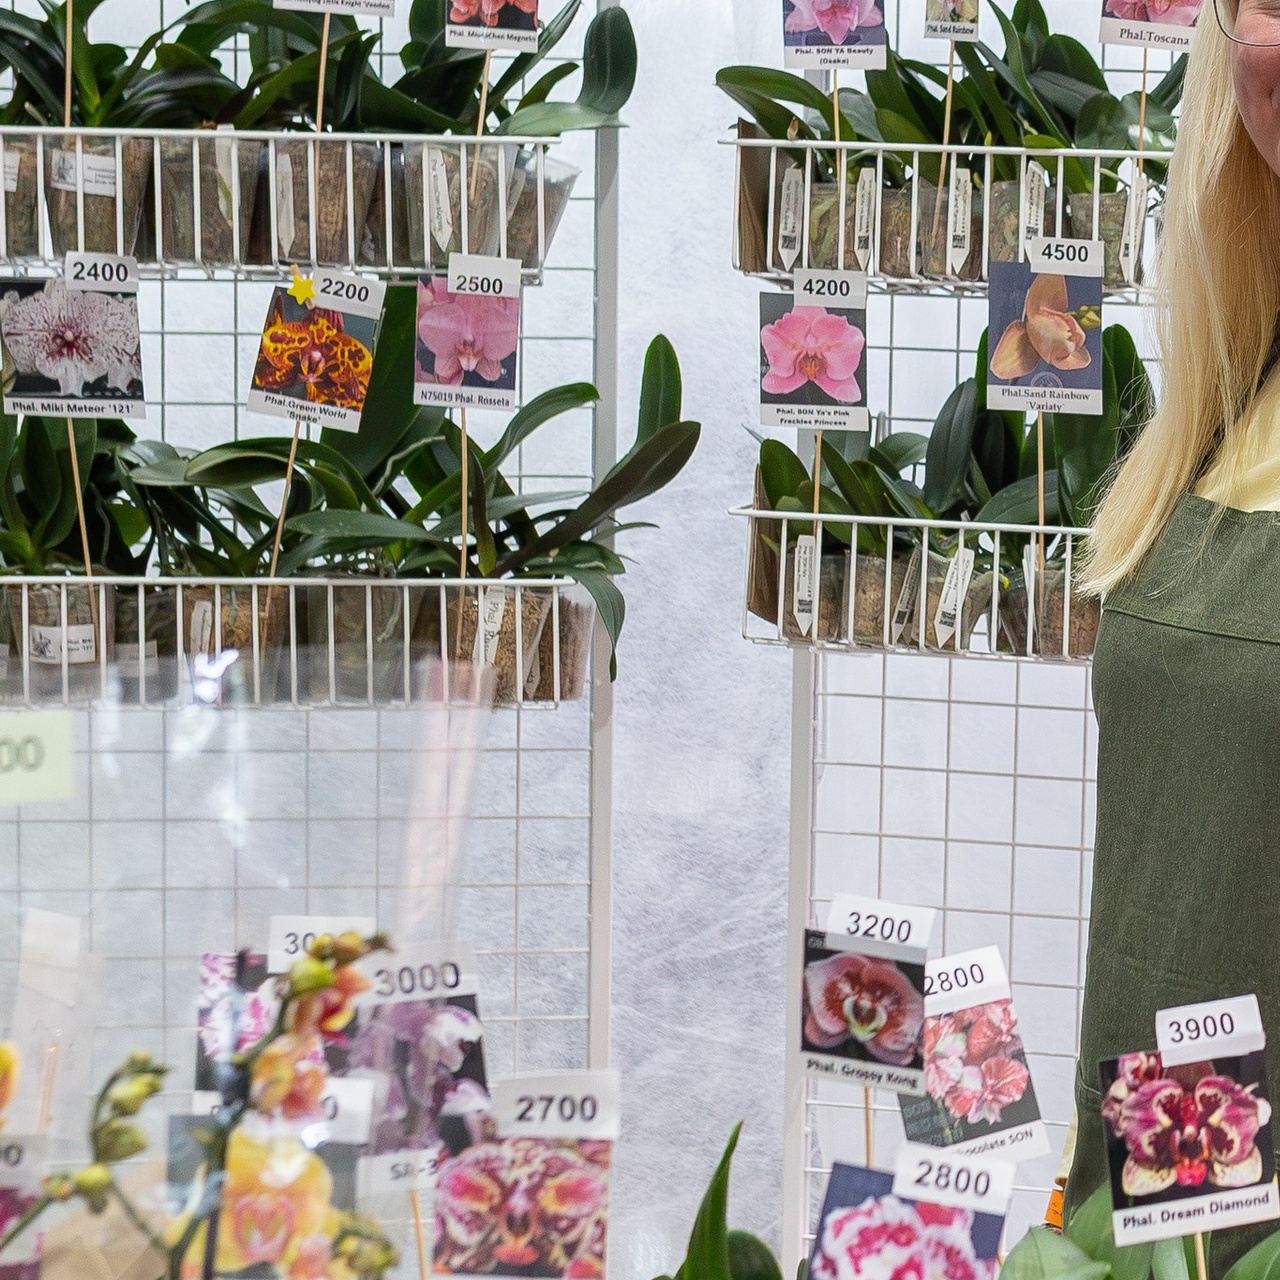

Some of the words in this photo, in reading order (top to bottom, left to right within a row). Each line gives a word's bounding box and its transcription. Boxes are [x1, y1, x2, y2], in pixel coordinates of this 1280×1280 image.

[1041, 244, 1089, 263] 4500
[73, 261, 130, 283] 2400
[456, 274, 503, 295] 2500
[320, 276, 370, 302] 2200
[802, 278, 850, 297] 4200
[12, 401, 39, 413] Phal.
[41, 403, 64, 414] Miki
[67, 404, 106, 414] Meteor
[108, 404, 134, 415] '121'
[421, 390, 453, 402] N75019
[455, 392, 476, 404] Phal.
[1049, 390, 1090, 402] Rainbow
[319, 405, 348, 420] World
[0, 737, 44, 772] 00
[847, 911, 912, 943] 3200
[376, 962, 459, 997] 3000
[925, 963, 985, 997] 2800
[1169, 1012, 1235, 1043] 3900
[516, 1096, 598, 1122] 2700
[915, 1160, 990, 1198] 2800
[1122, 1212, 1157, 1231] Phal.
[1161, 1204, 1206, 1223] Dream
[1209, 1190, 1271, 1215] Diamond
